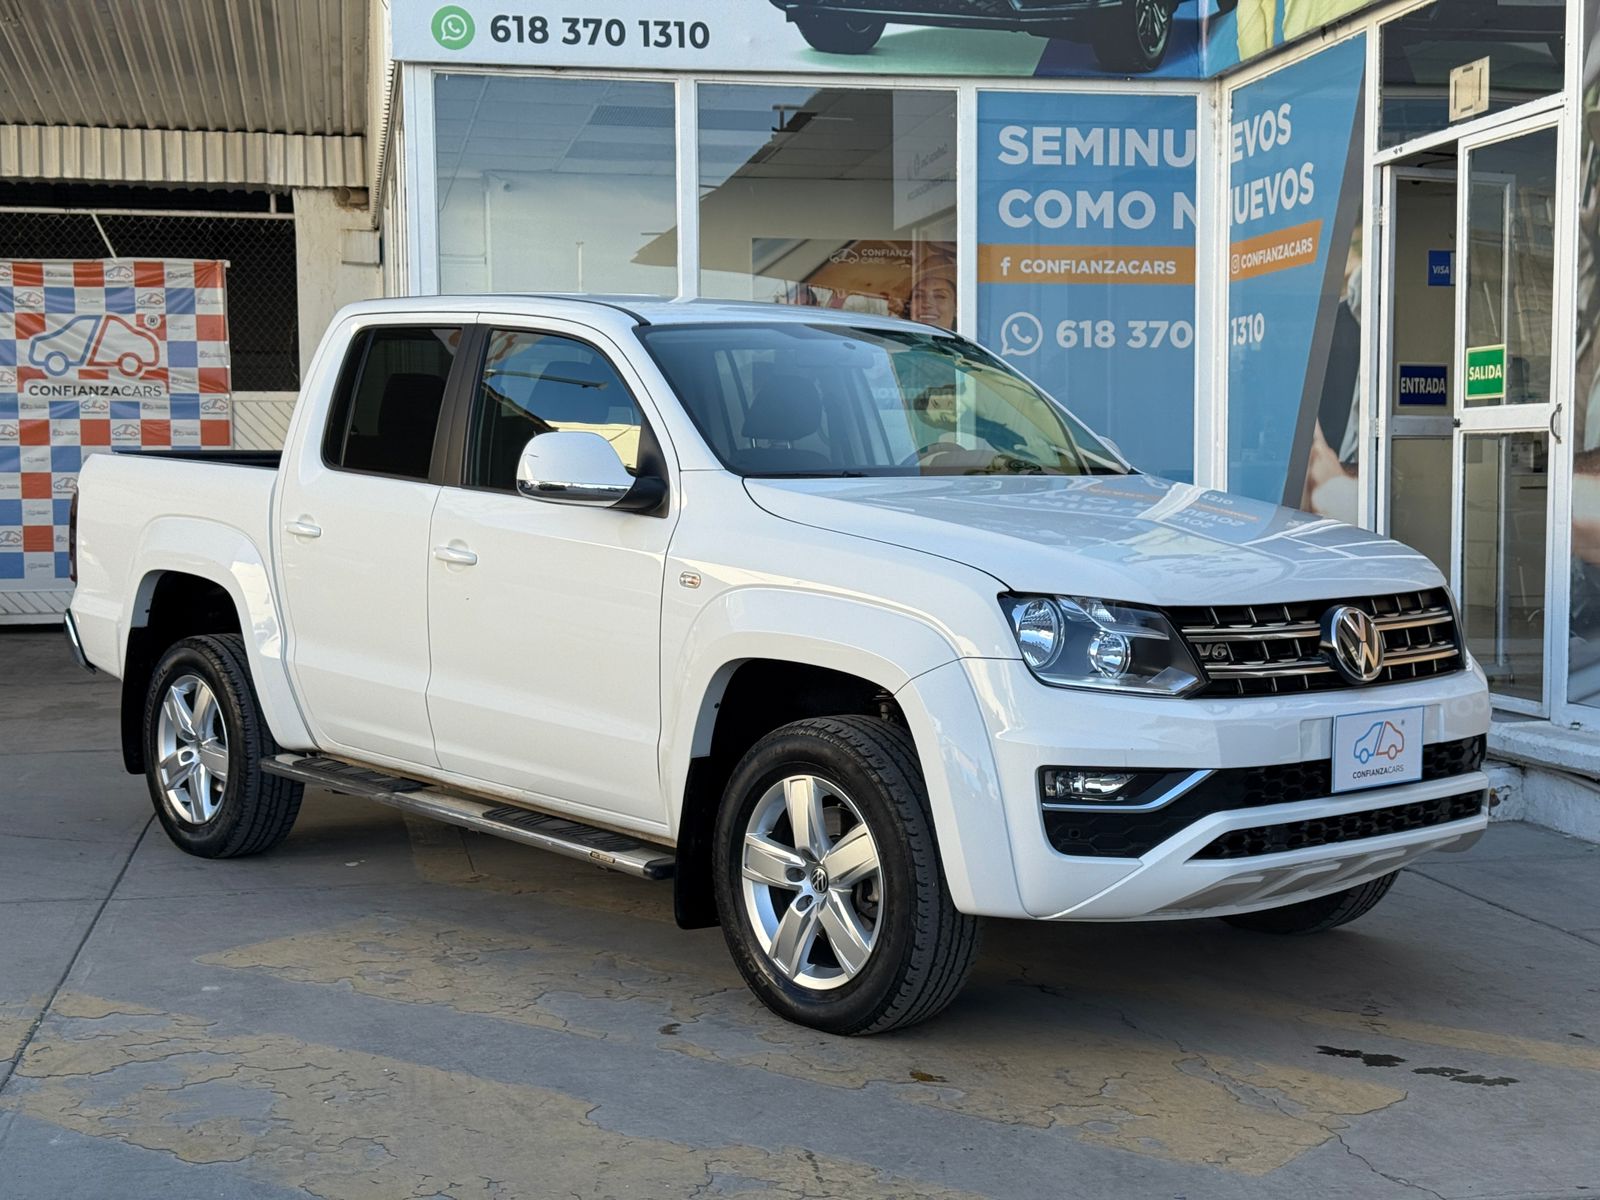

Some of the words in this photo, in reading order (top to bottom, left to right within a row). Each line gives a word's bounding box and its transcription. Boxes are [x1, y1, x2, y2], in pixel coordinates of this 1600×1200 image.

[490, 14, 550, 45] 618
[561, 17, 626, 47] 370
[638, 20, 710, 49] 1310
[998, 125, 1196, 168] SEMINU
[1230, 102, 1291, 164] EVOS
[998, 189, 1156, 230] COMO
[1230, 162, 1314, 226] UEVOS
[1241, 236, 1313, 269] CONFIANZACARS
[1020, 259, 1177, 275] CONFIANZACARS
[1432, 265, 1450, 275] VISA
[1056, 320, 1116, 348] 618
[1126, 320, 1194, 349] 370
[1231, 312, 1265, 346] 1310
[1468, 364, 1502, 381] SALIDA
[28, 385, 162, 397] CONFIANZACARS
[1400, 377, 1446, 394] ENTRADA
[1195, 643, 1227, 659] V6
[1352, 764, 1404, 779] CONFIANZACARS
